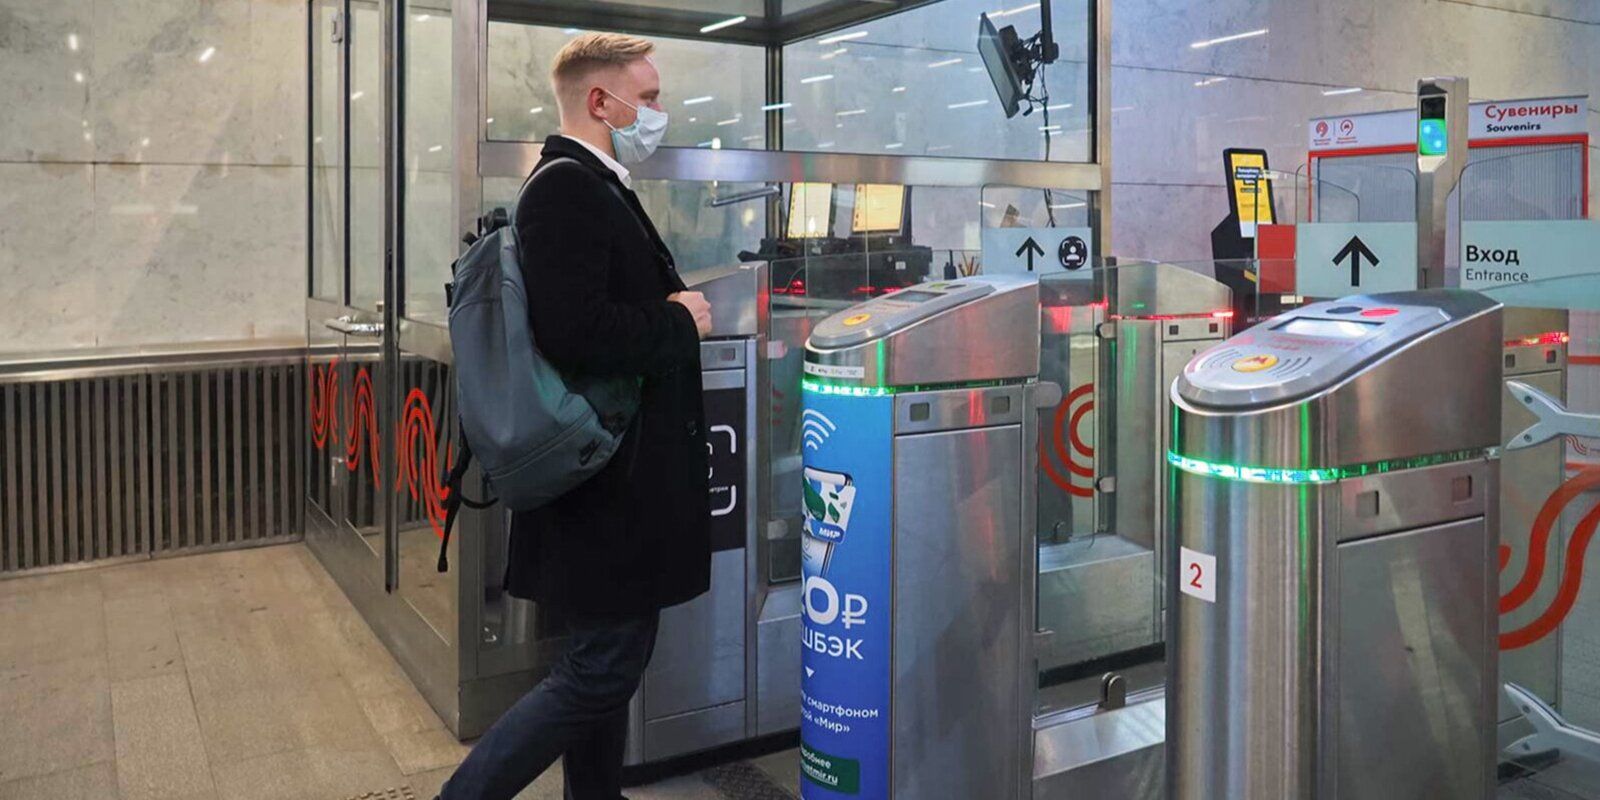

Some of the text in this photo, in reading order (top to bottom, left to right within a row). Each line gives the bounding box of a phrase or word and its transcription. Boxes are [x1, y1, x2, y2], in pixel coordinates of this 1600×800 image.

[1485, 104, 1578, 121] Сувениры
[1486, 122, 1541, 132] Souvenirs
[1466, 245, 1519, 265] Вход
[1466, 268, 1529, 282] Entrance
[1190, 562, 1202, 589] 2
[807, 696, 879, 718] смартфоном
